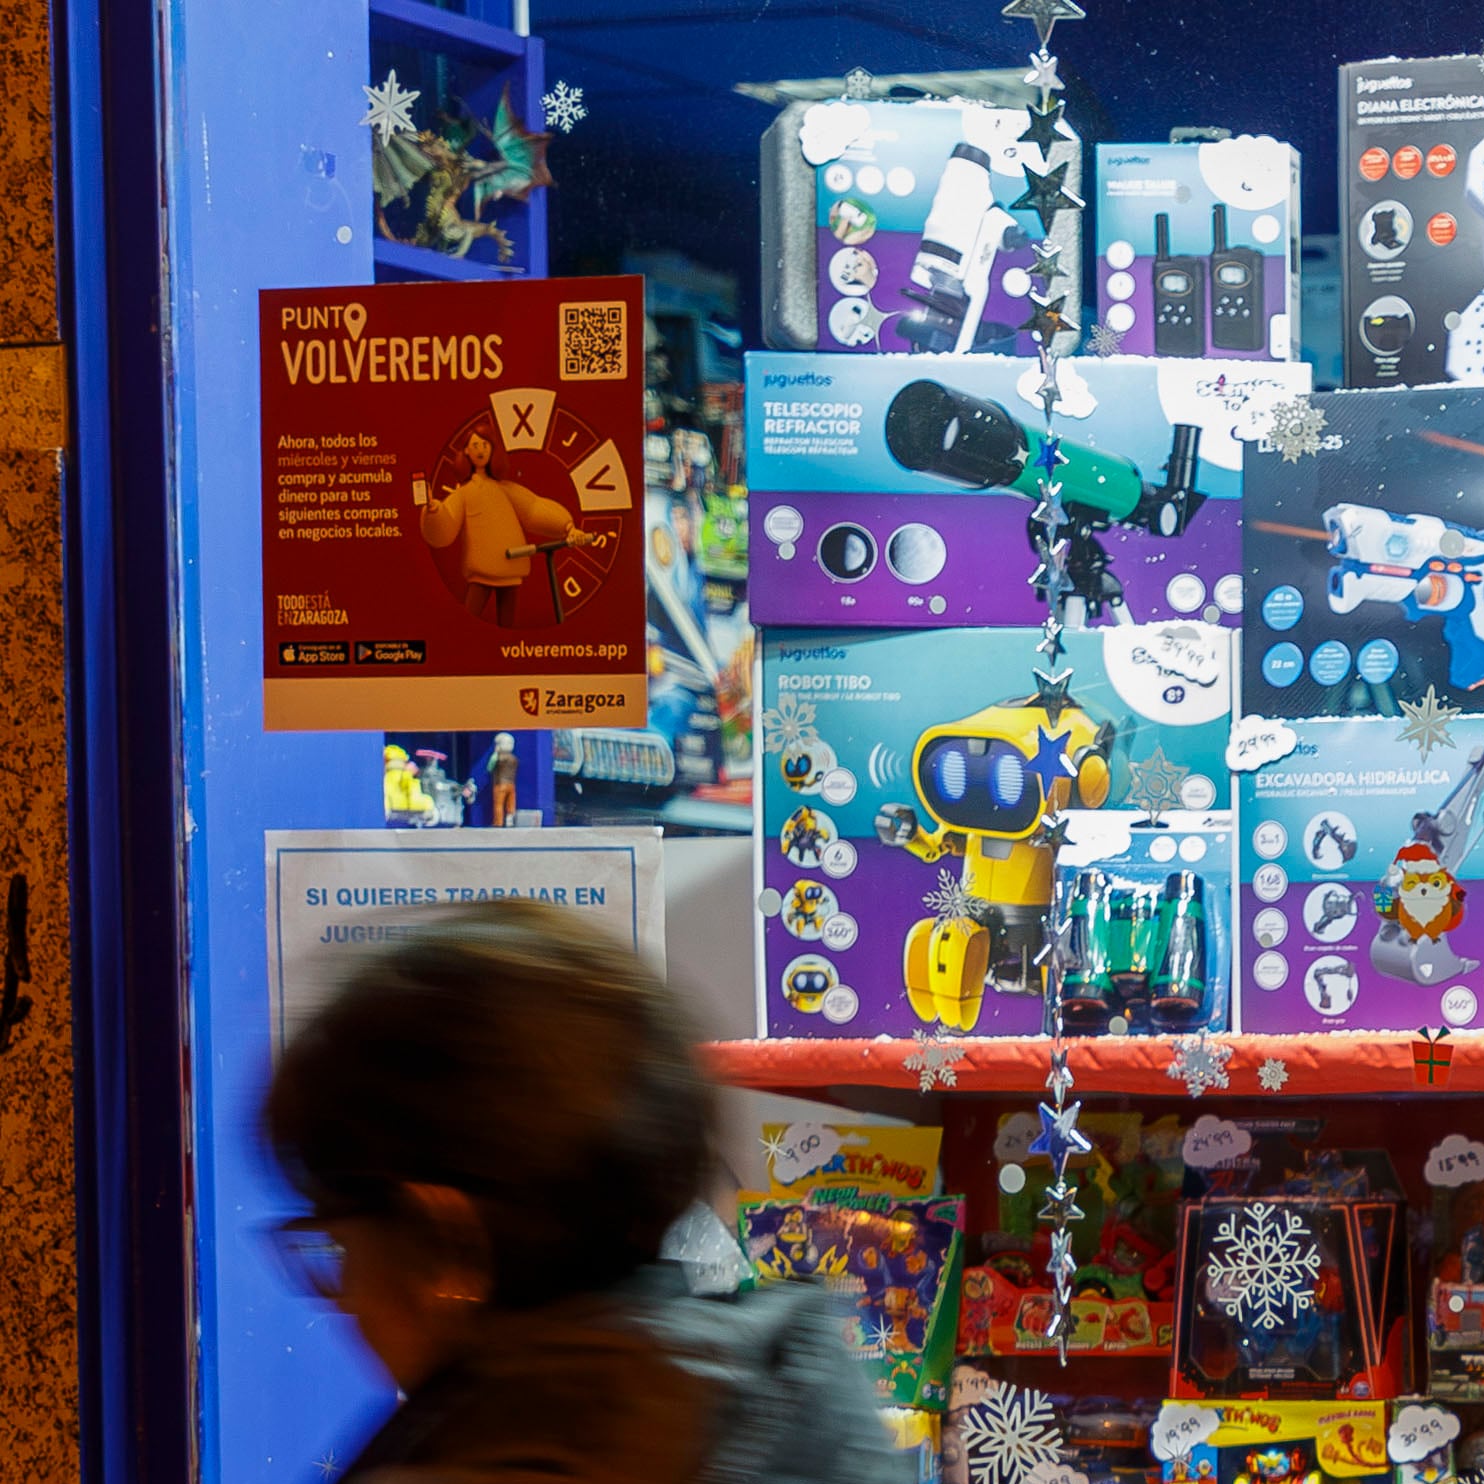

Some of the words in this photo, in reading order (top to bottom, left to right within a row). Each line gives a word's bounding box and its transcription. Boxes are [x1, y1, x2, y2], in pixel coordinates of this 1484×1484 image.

[1357, 98, 1399, 116] DIANA
[281, 334, 504, 385] VOLVEREMOS
[763, 370, 834, 388] juguettos
[763, 402, 864, 419] TELESCOPIO
[512, 403, 534, 438] X
[764, 418, 861, 435] REFRACTOR
[278, 435, 319, 450] Ahora,
[321, 433, 356, 448] todos
[360, 432, 378, 447] los
[278, 451, 339, 466] miércoles
[341, 455, 349, 469] y
[351, 452, 397, 465] viernes
[278, 473, 325, 488] compra
[328, 473, 337, 487] y
[339, 468, 392, 483] acumula
[278, 488, 317, 503] dinero
[320, 492, 348, 505] para
[351, 490, 371, 501] tus
[278, 507, 340, 524] siguientes
[343, 508, 398, 522] compras
[279, 528, 294, 539] en
[297, 524, 352, 541] negocios
[355, 522, 402, 538] locales.
[298, 651, 318, 663] App
[320, 651, 345, 662] Store
[375, 650, 403, 663] Google
[405, 650, 423, 662] Play
[501, 640, 628, 662] volveremos.app
[778, 643, 847, 661] juguettos
[778, 675, 832, 690] ROBOT
[835, 675, 872, 690] TIBO
[545, 690, 626, 714] Zaragoza
[1256, 773, 1357, 789] EXCAVADORA
[1359, 768, 1450, 786] HIDRÁULICA
[306, 888, 328, 906] SI
[336, 888, 437, 907] QUIERES
[575, 888, 606, 905] EN
[1165, 1417, 1201, 1444] 19'99
